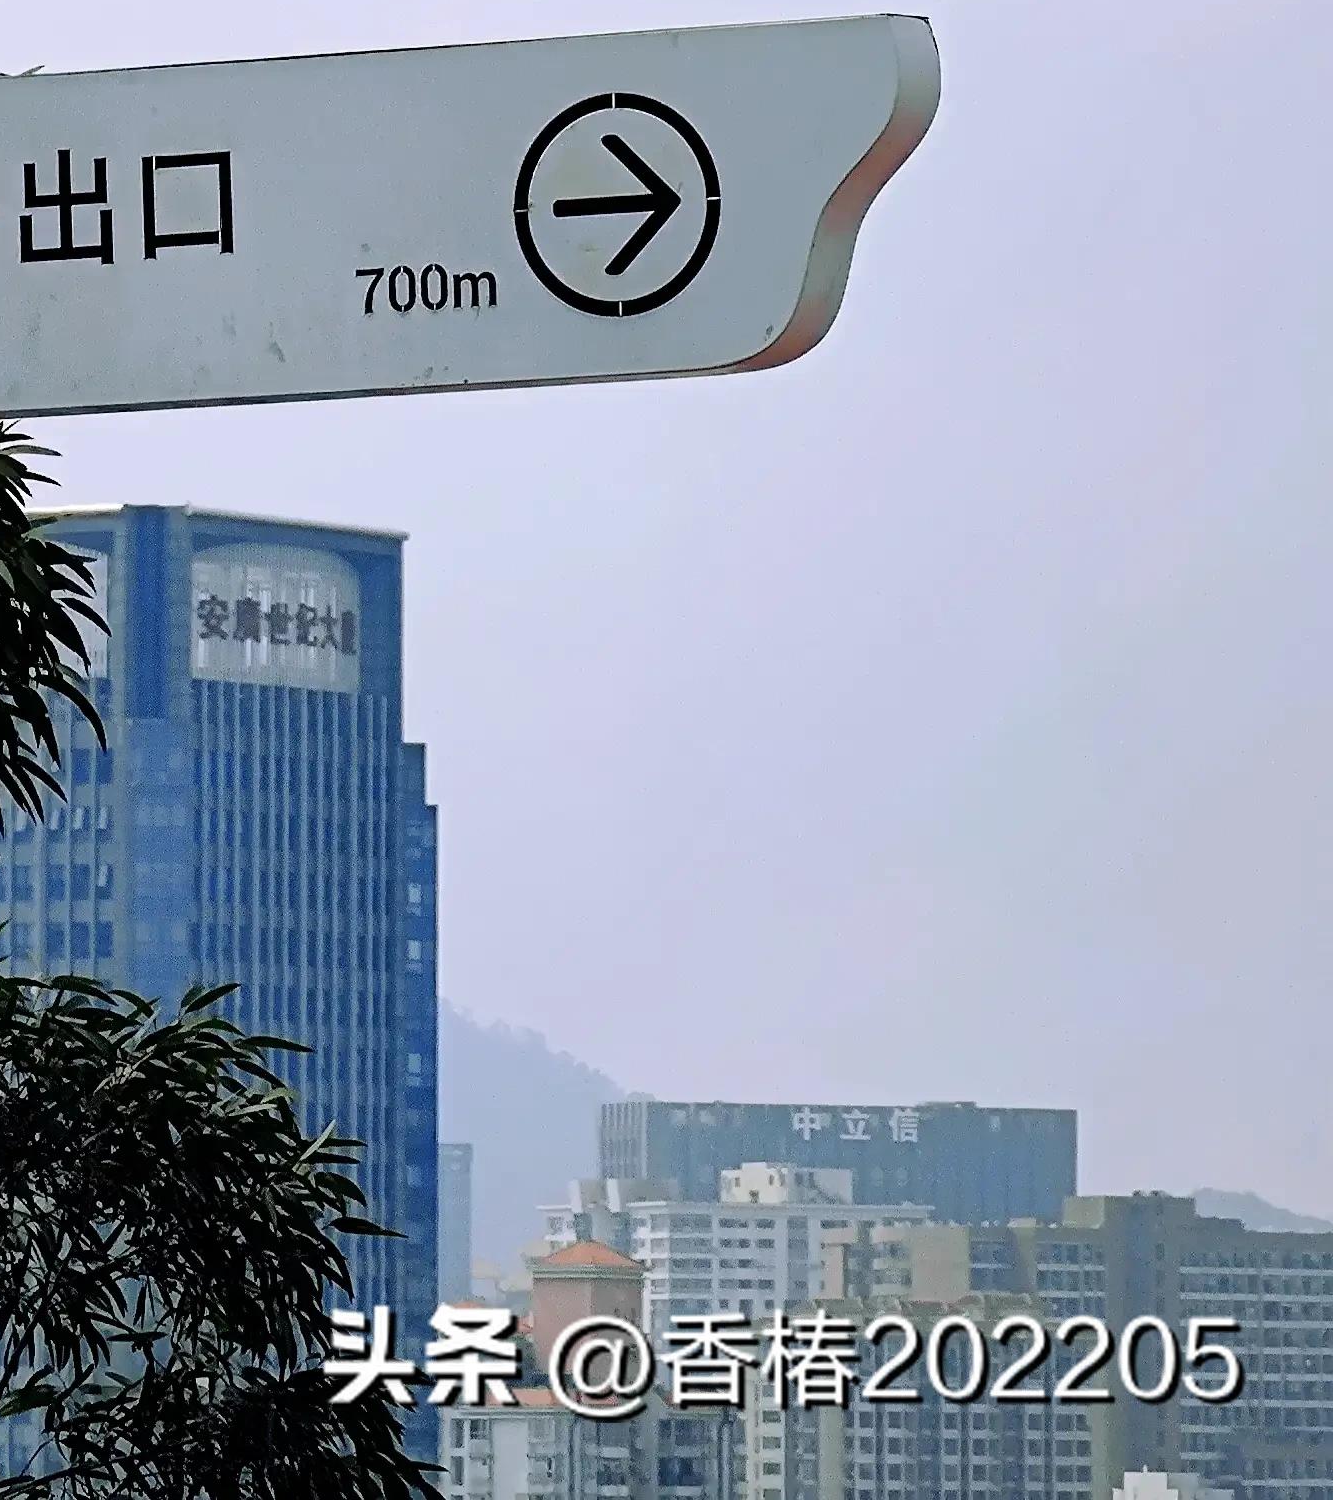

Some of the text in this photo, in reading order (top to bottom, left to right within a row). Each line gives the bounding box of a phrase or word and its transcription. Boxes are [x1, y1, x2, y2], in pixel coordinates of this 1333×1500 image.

[355, 263, 498, 315] 700m
[792, 1107, 920, 1143] 中立信
